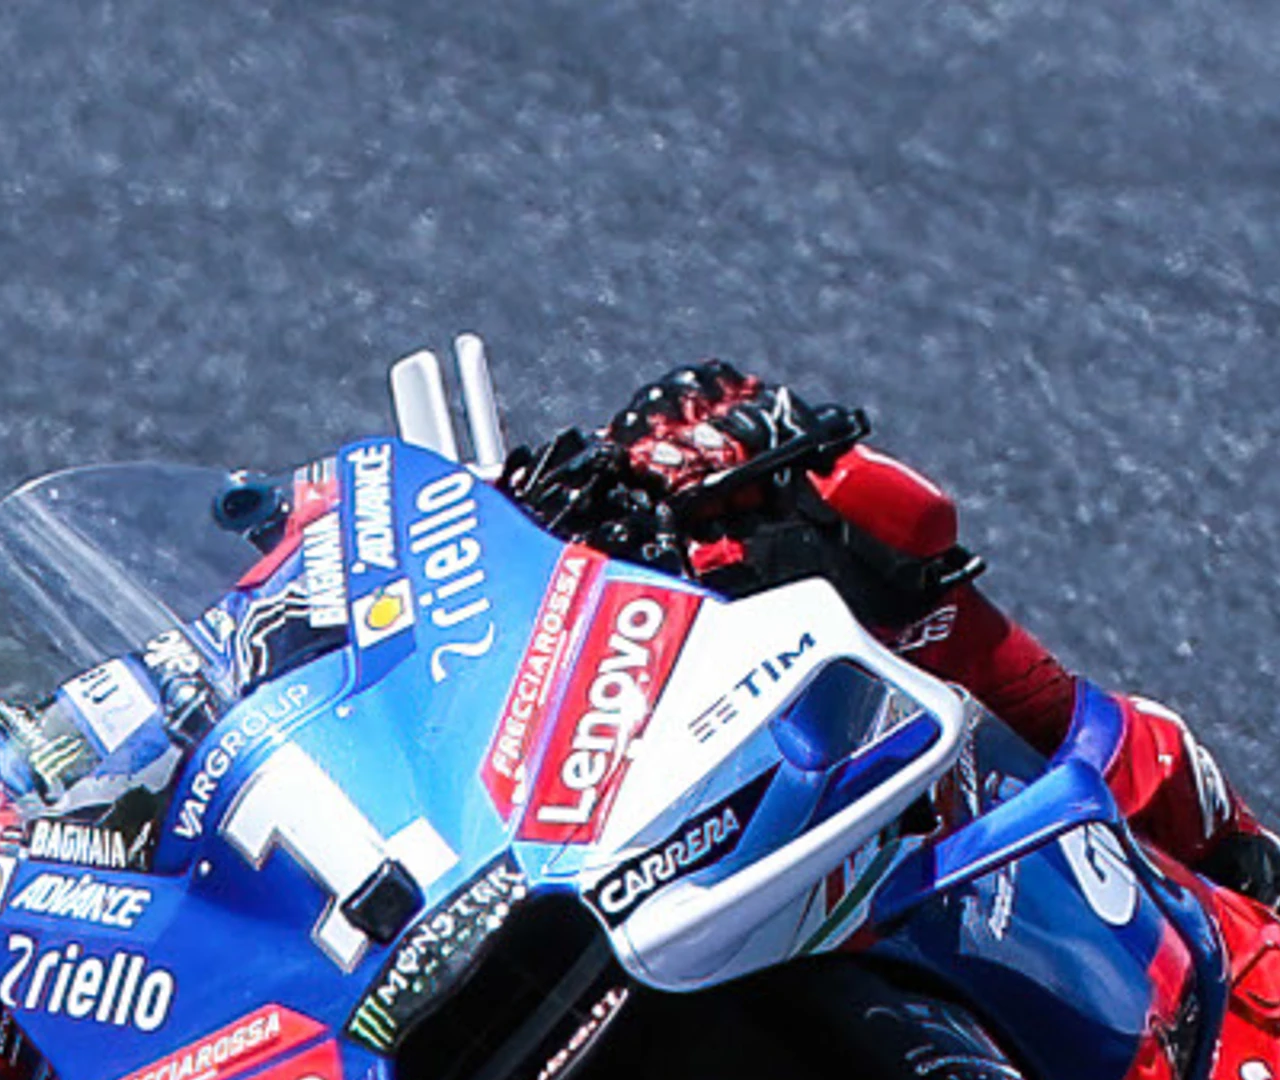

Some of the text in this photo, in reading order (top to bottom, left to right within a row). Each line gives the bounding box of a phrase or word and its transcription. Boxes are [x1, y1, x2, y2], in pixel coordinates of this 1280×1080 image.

[348, 444, 398, 572] ADVANCE
[537, 597, 666, 824] Lenovo
[734, 632, 817, 698] TIM
[174, 682, 309, 839] VARGROUP
[30, 820, 126, 868] BAGNAIA
[599, 808, 741, 914] CARRERA
[9, 872, 152, 928] ADVANCE
